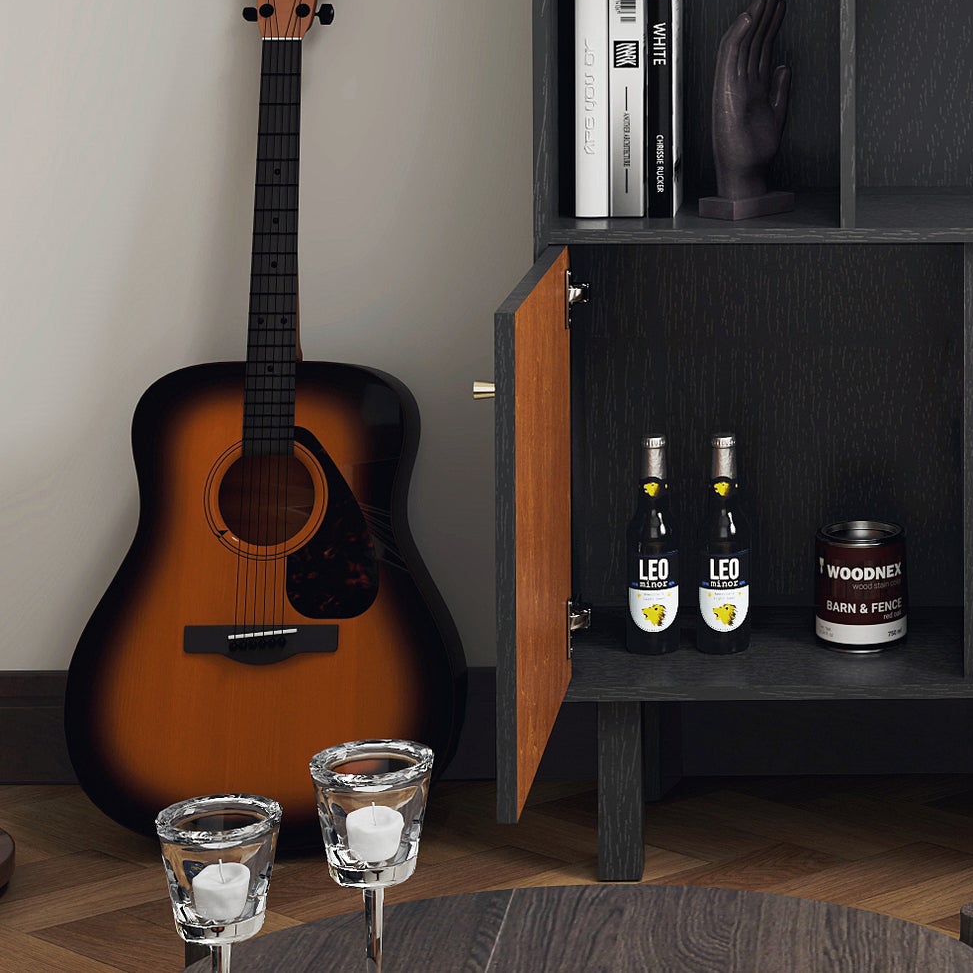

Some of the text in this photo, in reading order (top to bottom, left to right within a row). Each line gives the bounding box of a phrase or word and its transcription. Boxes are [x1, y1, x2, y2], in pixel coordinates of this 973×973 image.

[652, 22, 667, 66] WHITE
[656, 134, 665, 193] CHRISSIE RUCKER
[639, 558, 669, 580] LEO
[710, 558, 740, 580] LEO
[826, 562, 902, 581] WOODNEX
[826, 597, 902, 614] BARN & FENCE
